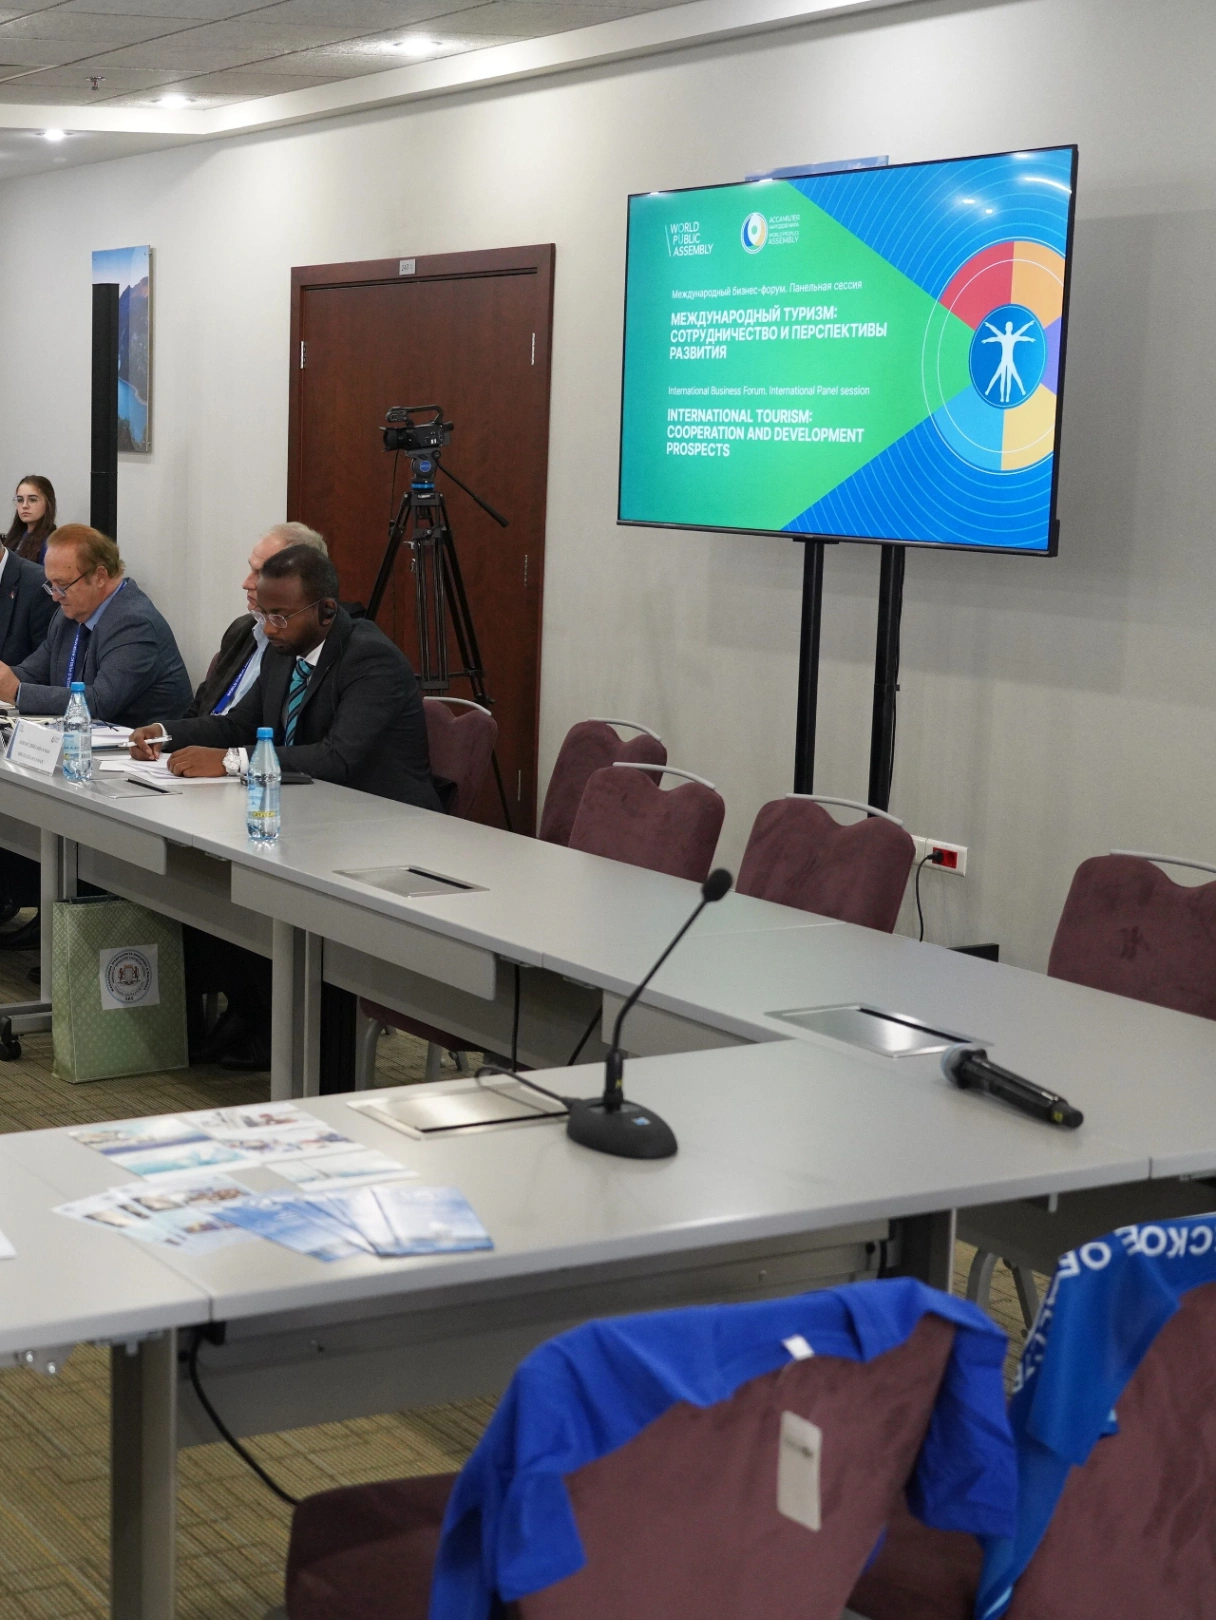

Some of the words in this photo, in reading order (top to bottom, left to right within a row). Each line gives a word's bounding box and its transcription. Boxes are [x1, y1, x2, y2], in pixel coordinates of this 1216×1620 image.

[670, 221, 700, 235] WORLD
[672, 233, 700, 245] PUBLIC
[673, 243, 714, 257] ASSEMBLY
[671, 286, 731, 300] Международный
[732, 283, 788, 297] бизнес-форум.
[789, 281, 832, 293] Панельная
[834, 280, 863, 291] сессия
[670, 305, 781, 327] МЕЖДУНАРОДНЫЙ
[783, 305, 838, 321] ТУРИЗМ:
[670, 325, 778, 344] СОТРУДНИЧЕСТВО
[780, 325, 789, 340] И
[791, 322, 888, 340] ПЕРСПЕКТИВЫ
[669, 345, 727, 360] РАЗВИТИЯ
[668, 386, 710, 396] International
[710, 386, 742, 396] Business
[743, 386, 767, 396] Forum.
[769, 385, 816, 396] International
[817, 385, 839, 396] Panel
[840, 385, 870, 396] session
[667, 408, 754, 423] INTERNATIONAL
[756, 409, 813, 424] TOURISM:
[667, 425, 745, 440] COOPERATION
[746, 426, 772, 441] AND
[773, 427, 865, 443] DEVELOPMENT
[666, 441, 731, 457] PROSPECTS
[1113, 1224, 1216, 1259] СКОЕ
